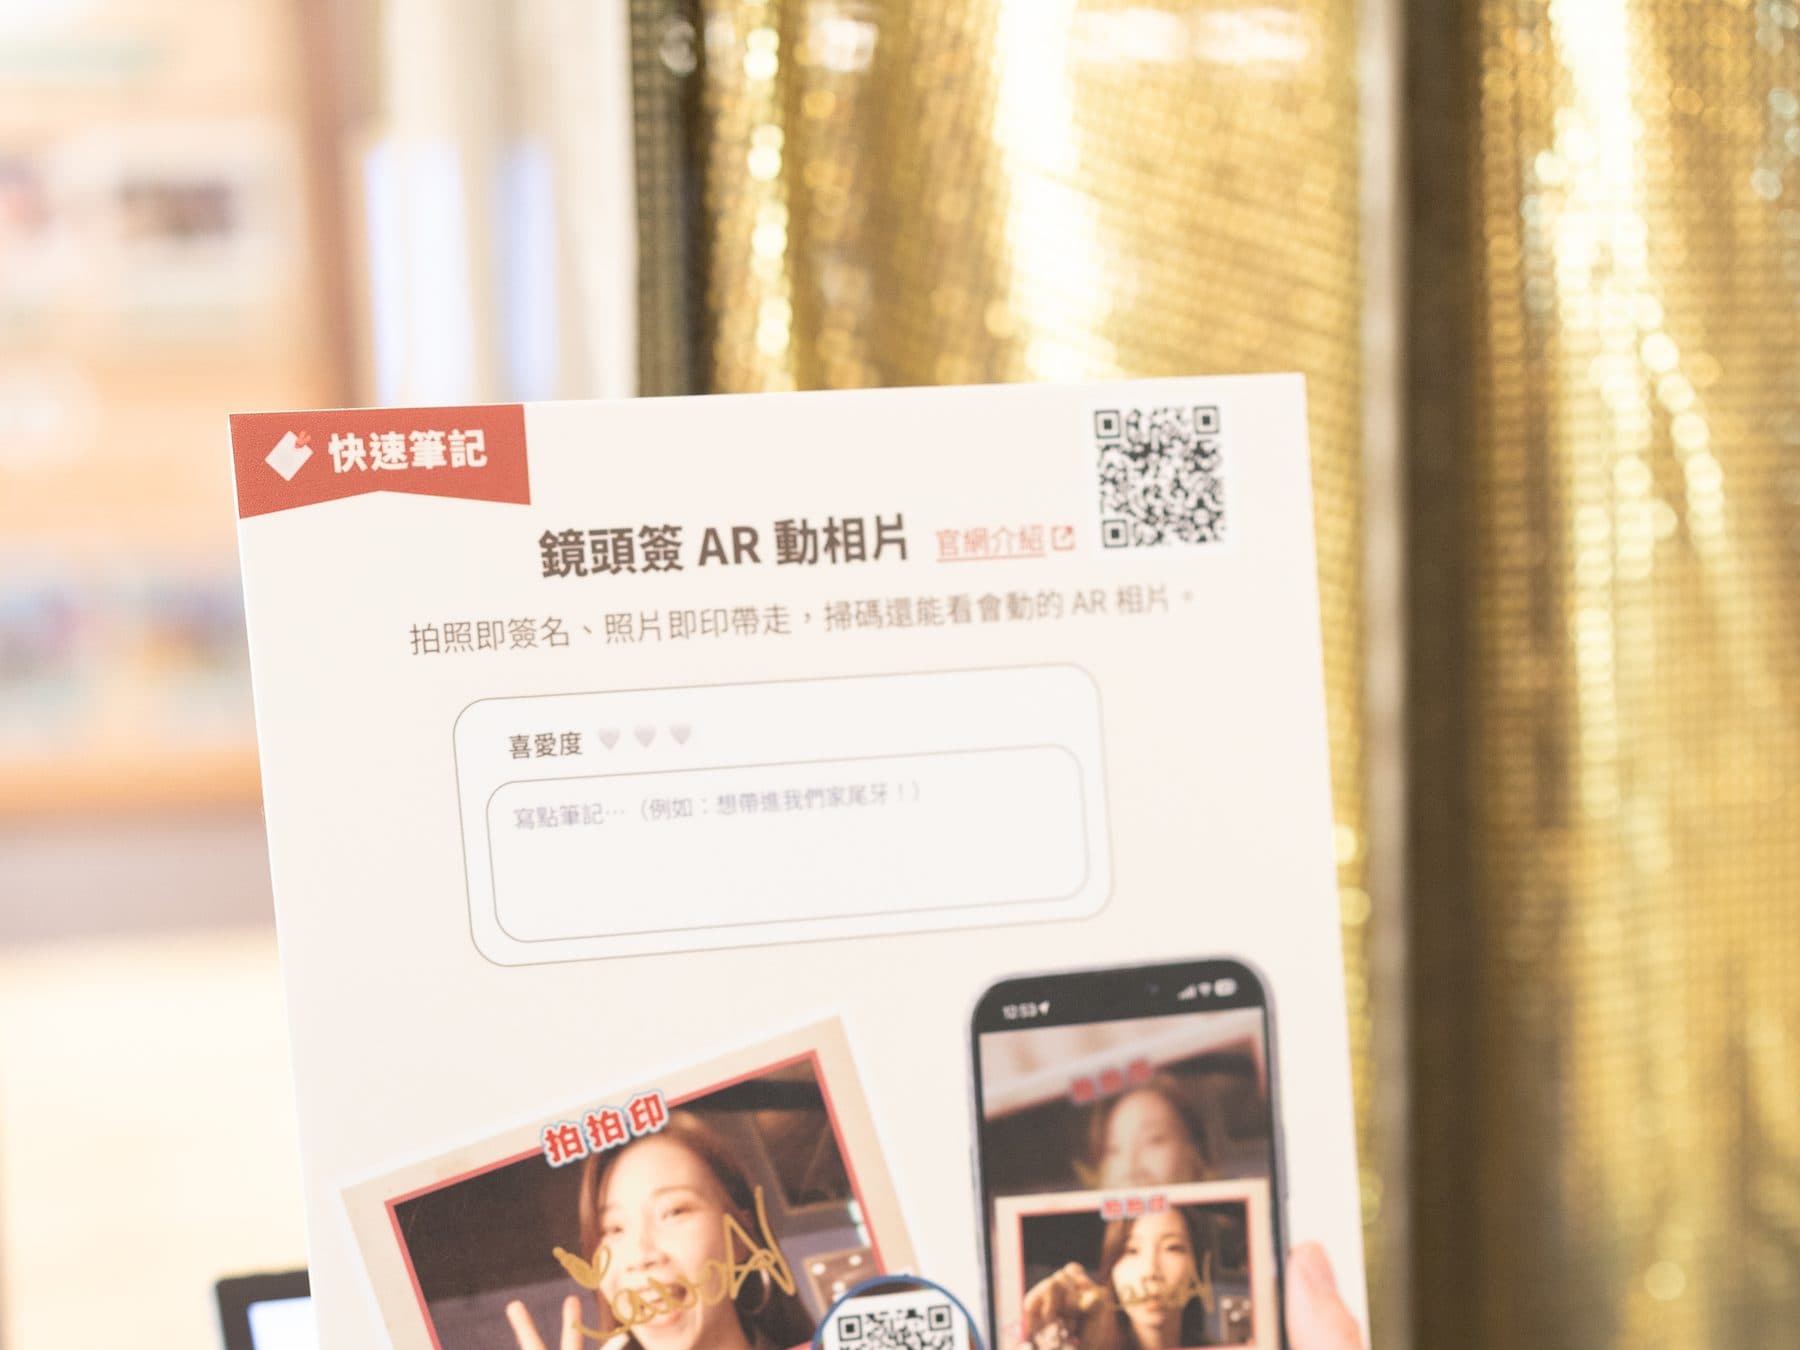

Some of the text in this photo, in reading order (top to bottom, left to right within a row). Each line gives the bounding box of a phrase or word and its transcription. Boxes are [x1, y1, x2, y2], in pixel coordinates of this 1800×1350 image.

[328, 429, 488, 473] 快速筆記
[539, 513, 908, 578] 鏡頭簽 AR 動相片
[936, 525, 1046, 560] 官網介紹
[1071, 589, 1108, 615] AR
[508, 731, 584, 760] 喜愛度
[543, 1092, 669, 1165] 拍拍印
